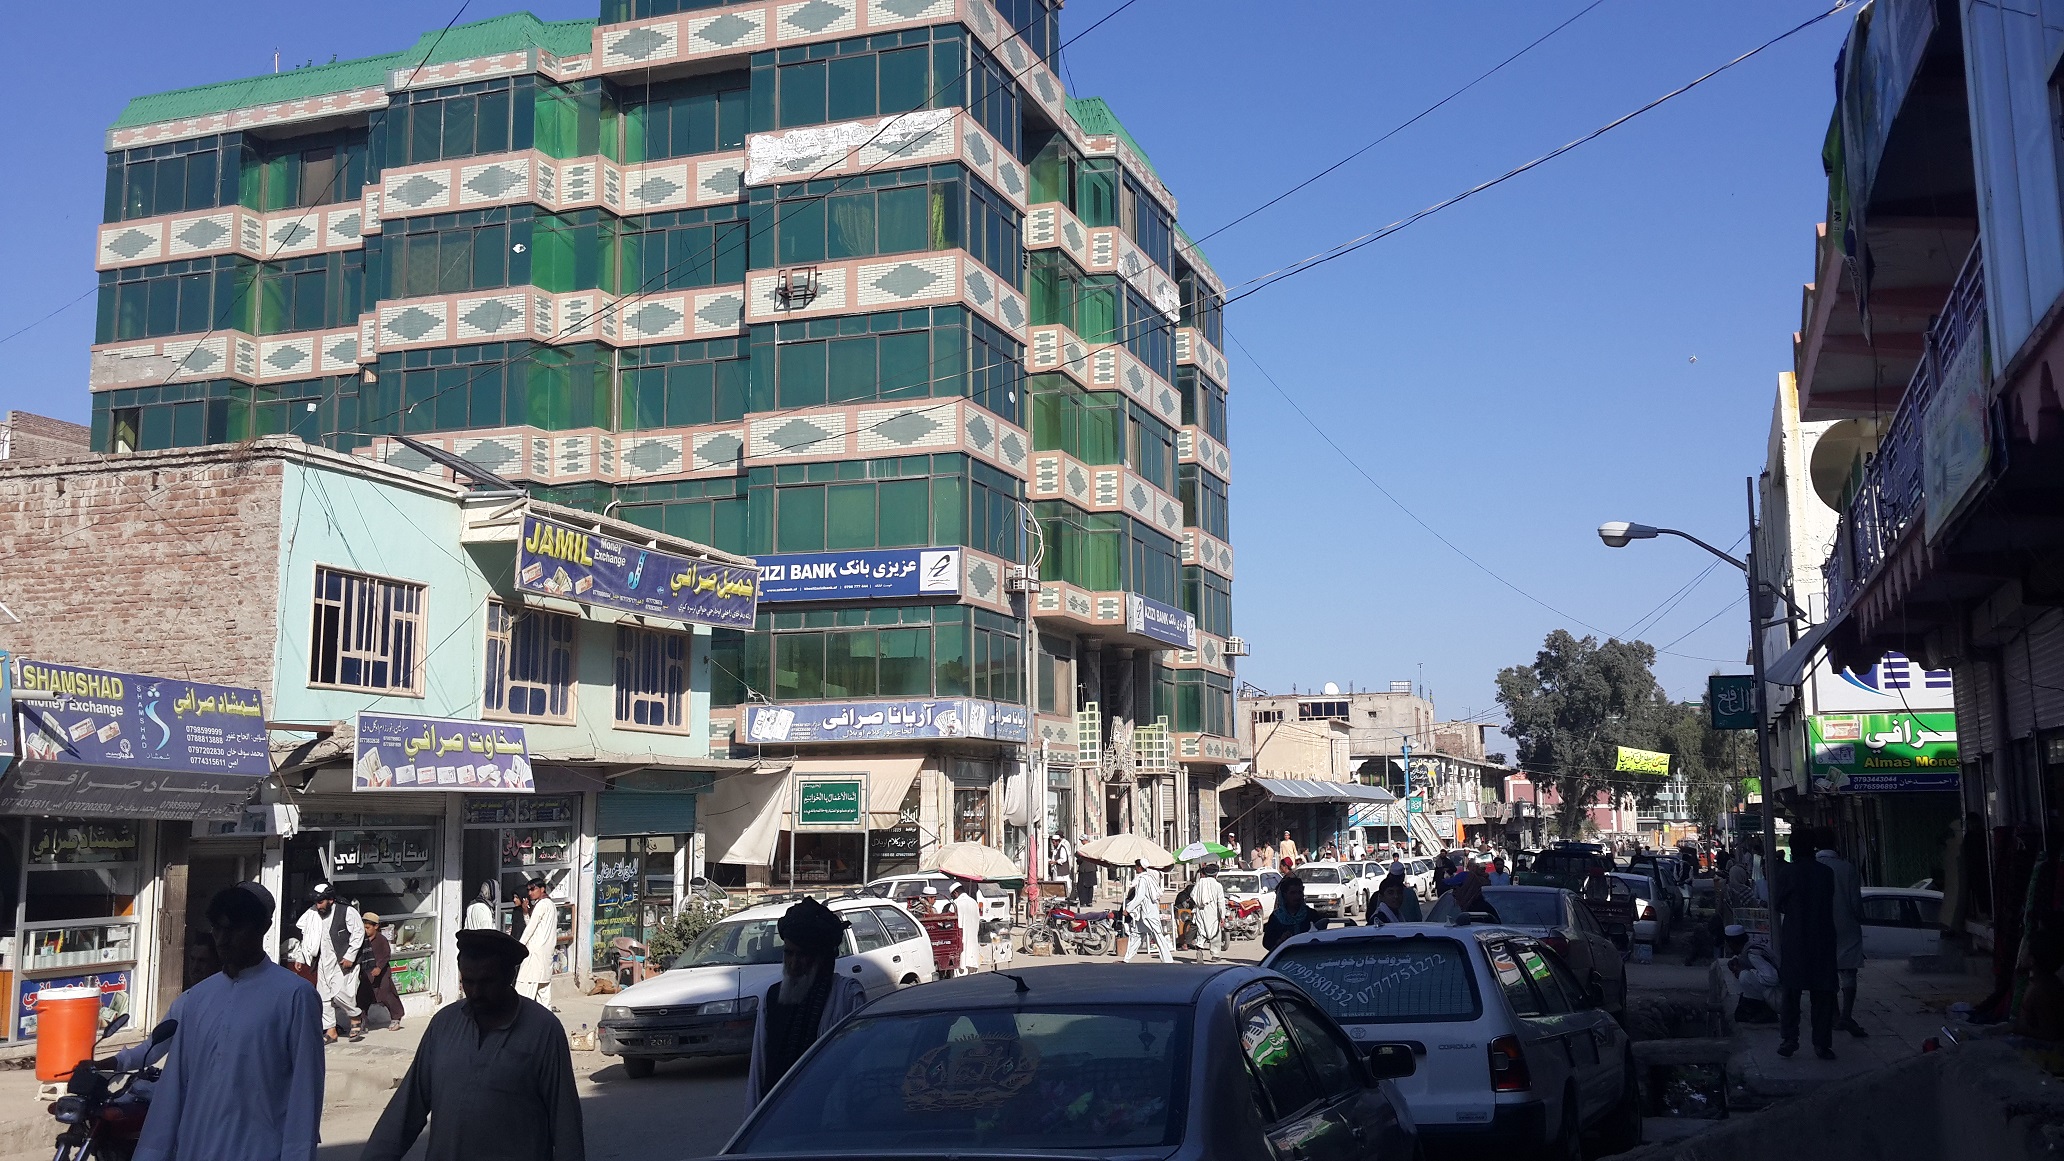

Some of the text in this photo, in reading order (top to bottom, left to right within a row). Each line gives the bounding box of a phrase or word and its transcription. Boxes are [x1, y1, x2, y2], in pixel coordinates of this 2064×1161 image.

[525, 521, 593, 567] JAMIL
[600, 537, 623, 555] Money
[594, 548, 627, 568] Exchange
[758, 562, 838, 581] ZIZI BANK
[1156, 609, 1169, 625] BANK
[23, 664, 124, 700] SHAMSHAD
[27, 699, 124, 717] Money Exchange
[136, 685, 147, 749] SHAMSHAD
[1864, 756, 1959, 768] Almas Mone
[1438, 1042, 1478, 1050] COROLLA
